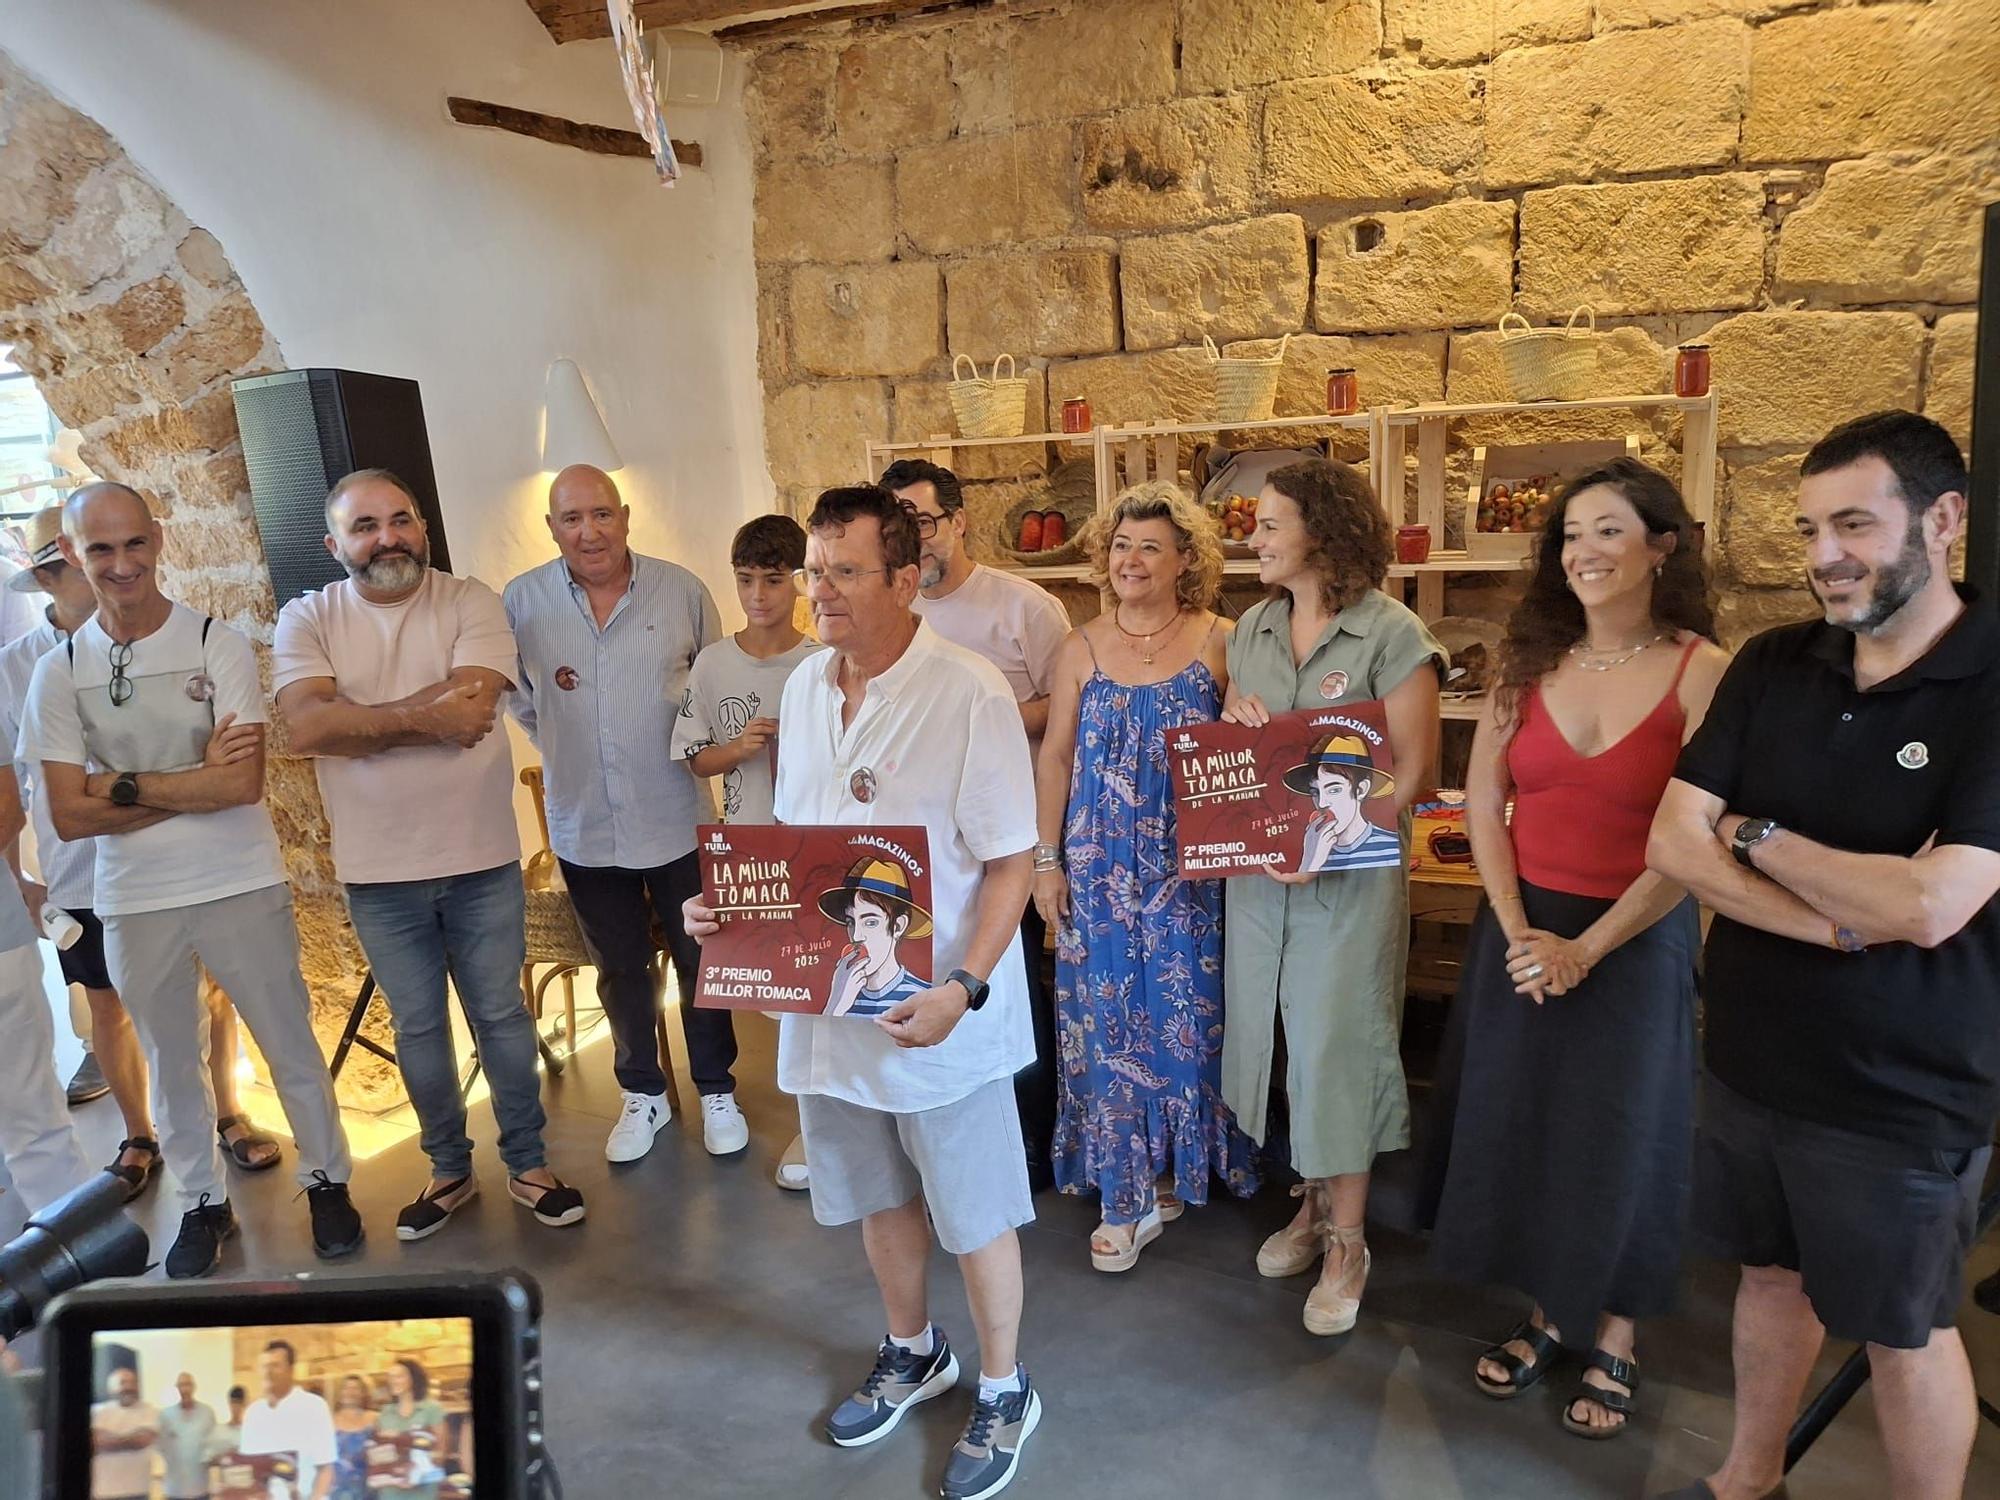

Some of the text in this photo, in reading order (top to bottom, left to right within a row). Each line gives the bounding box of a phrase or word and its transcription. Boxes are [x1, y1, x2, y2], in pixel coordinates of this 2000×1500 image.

[1318, 715, 1383, 745] MAGAZINOS
[1172, 741, 1199, 750] TURIA
[1182, 758, 1203, 777] LA
[1191, 801, 1203, 809] DE
[1211, 796, 1222, 804] LA
[1265, 823, 1290, 838] 2025
[704, 842, 733, 851] TURIA
[1198, 841, 1246, 855] PREMIO
[857, 833, 924, 877] MAGAZINOS
[1185, 852, 1287, 870] MILLOR TOMACA
[713, 862, 734, 885] LA
[720, 913, 733, 923] DE
[741, 911, 753, 920] LA
[794, 943, 805, 954] DE
[793, 954, 820, 969] 2025
[721, 967, 772, 982] PREMIO
[703, 982, 812, 1001] MILLOR TOMACA
